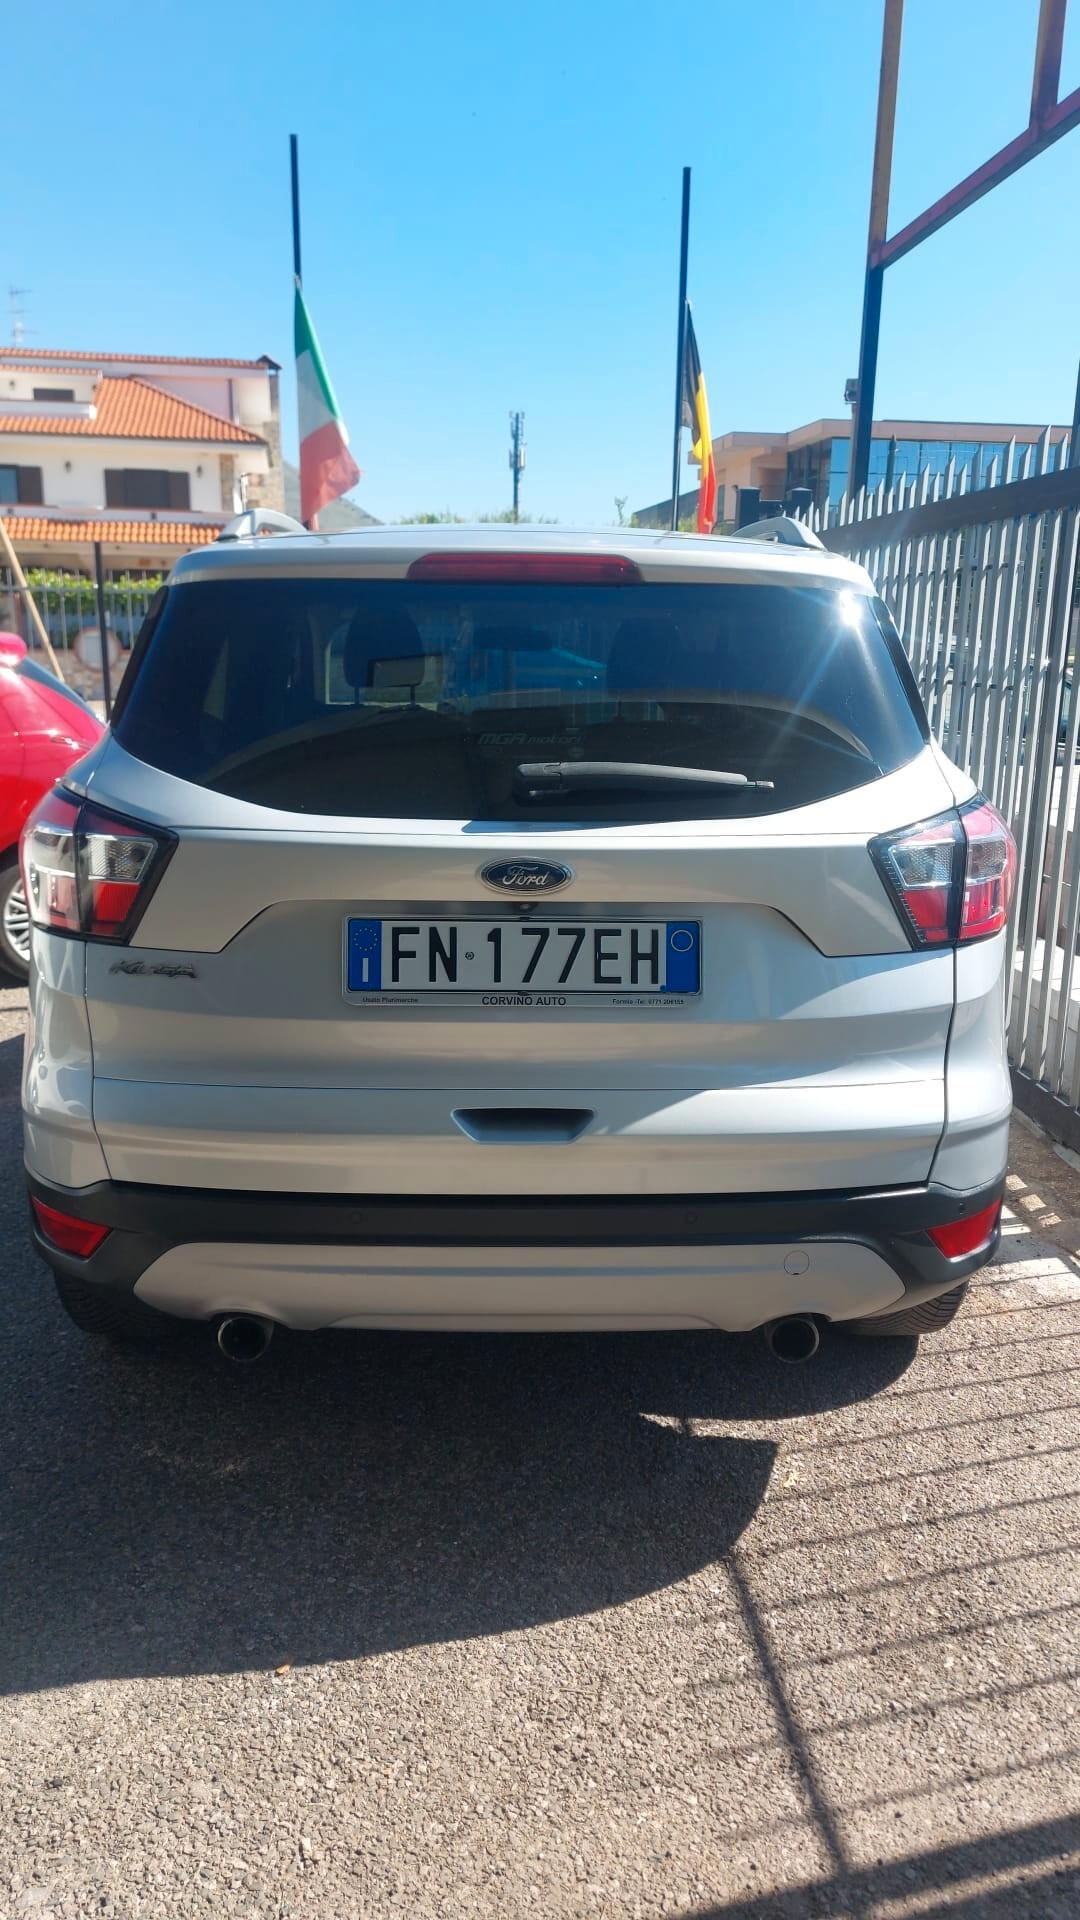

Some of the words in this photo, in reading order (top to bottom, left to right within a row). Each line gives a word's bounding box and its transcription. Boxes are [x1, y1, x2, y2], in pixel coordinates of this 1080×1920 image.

[502, 865, 550, 886] Ford
[481, 996, 533, 1006] CORVINO
[535, 996, 567, 1006] AUTO
